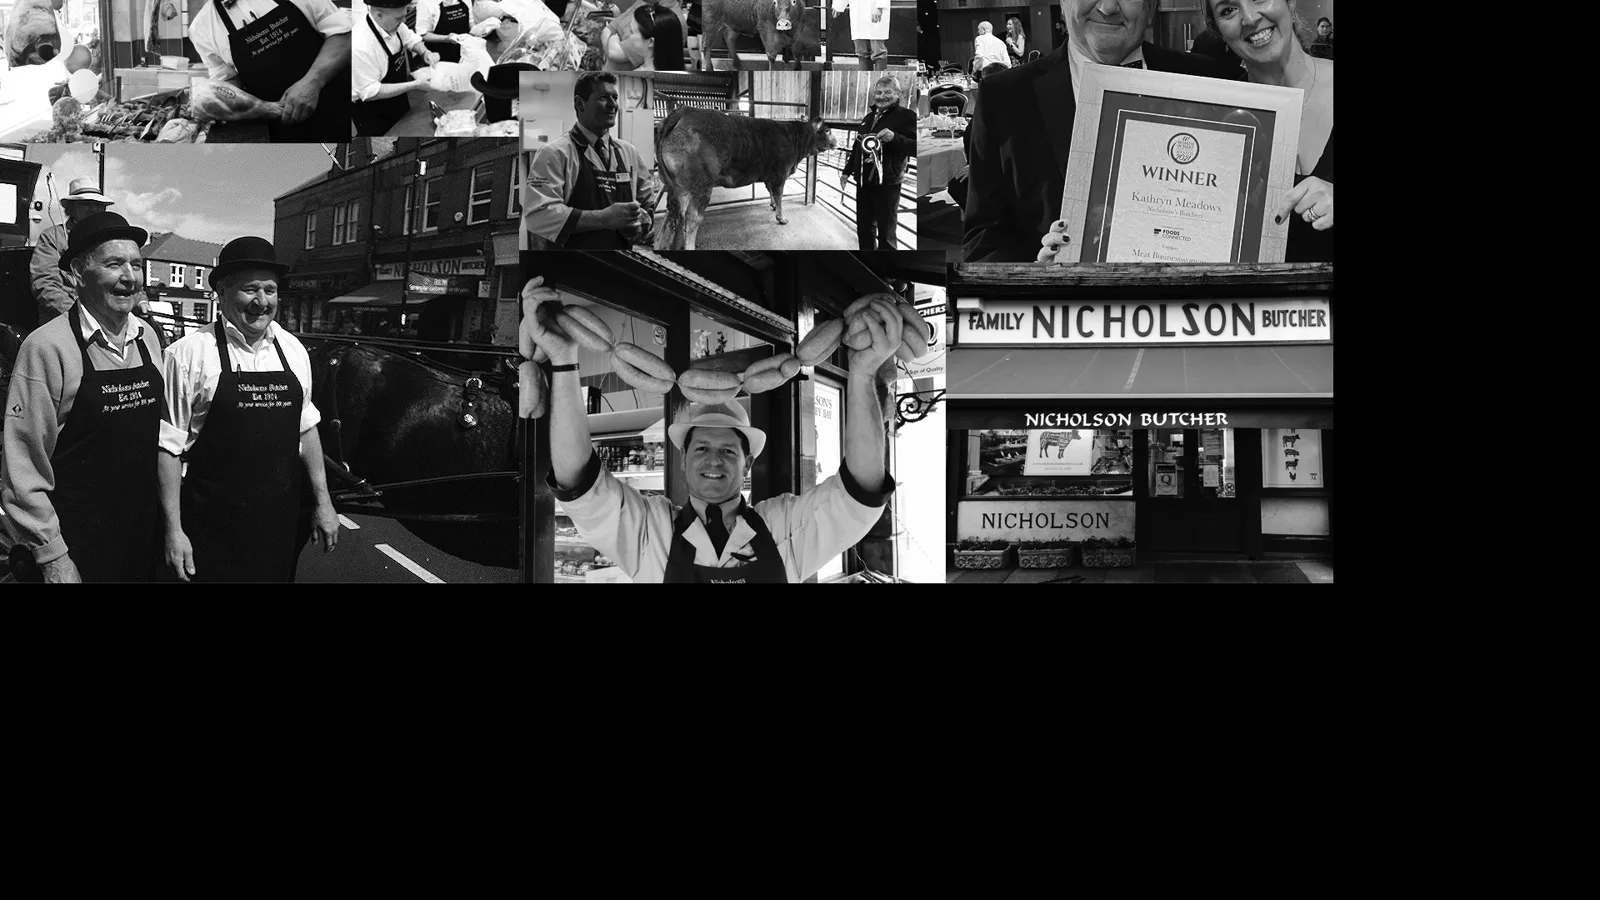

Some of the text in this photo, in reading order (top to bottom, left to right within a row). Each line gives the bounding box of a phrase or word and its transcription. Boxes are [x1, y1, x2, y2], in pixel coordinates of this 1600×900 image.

[269, 16, 289, 30] Butcher
[269, 28, 283, 39] 1914
[1176, 153, 1192, 161] 2021
[1142, 164, 1218, 188] WINNER
[1131, 191, 1222, 212] Kathryn Meadows
[1147, 206, 1204, 219] Nicholson's Butchers
[1161, 233, 1192, 242] CONNECTED
[1132, 248, 1151, 258] Meat
[968, 302, 1327, 338] FAMILY NICHOLSON BUTCHER
[926, 365, 944, 374] Quality
[1024, 412, 1229, 427] NICHOLSON BUTCHER
[981, 512, 1110, 529] NICHOLSON
